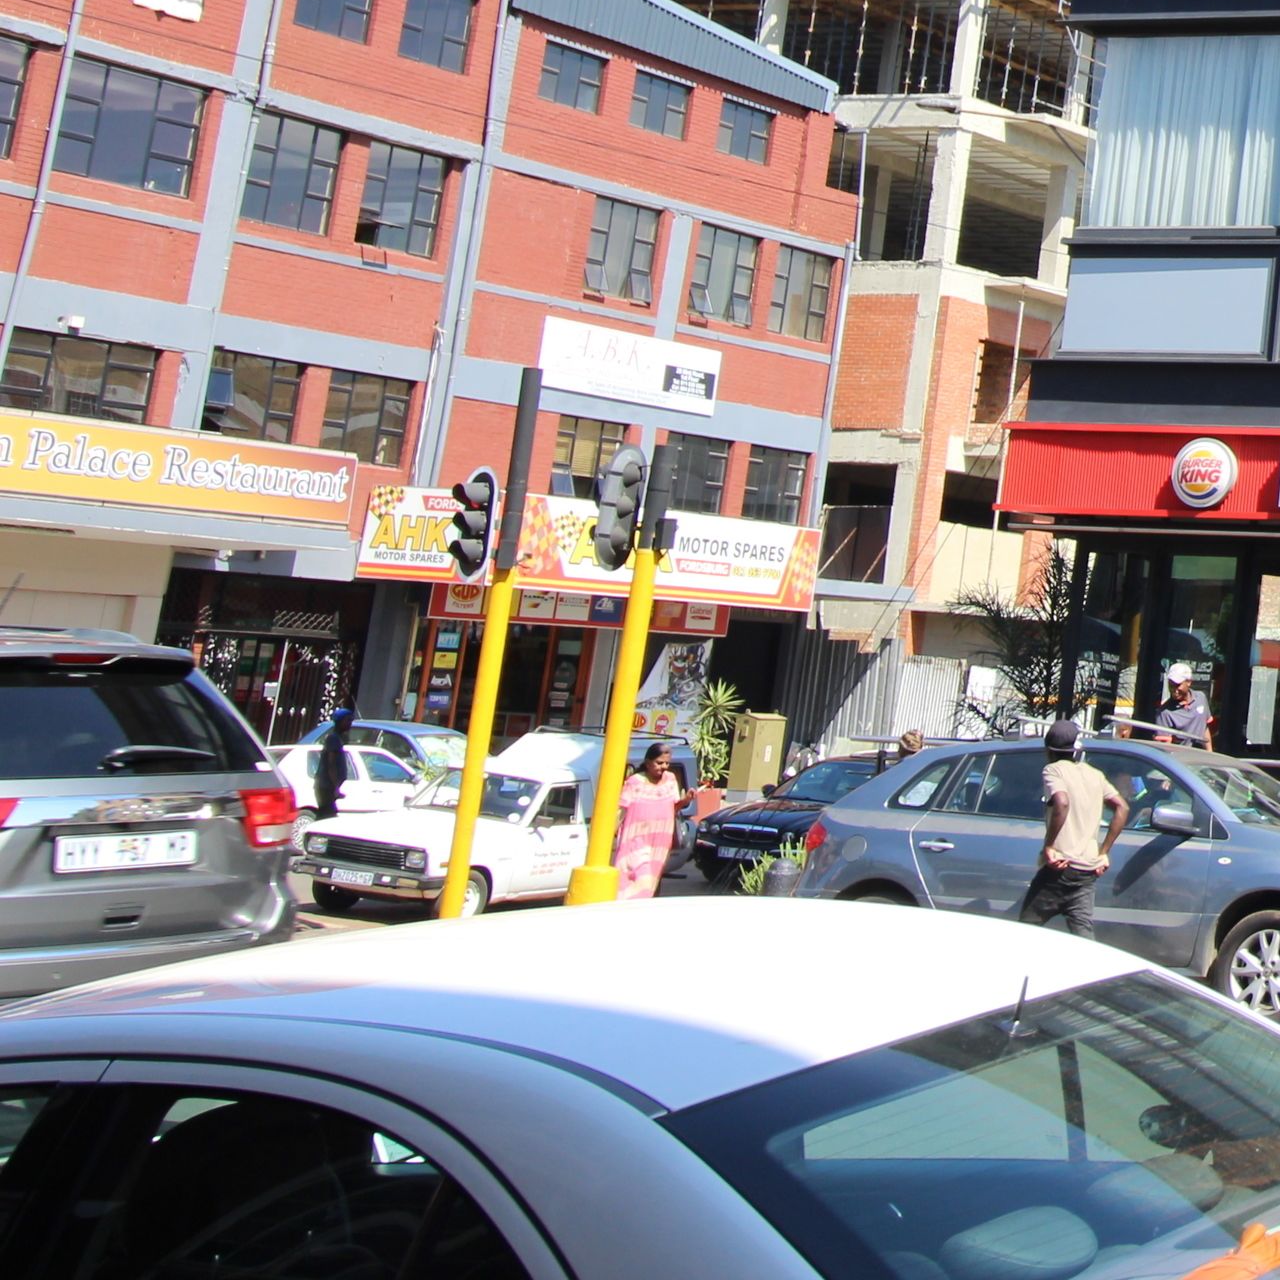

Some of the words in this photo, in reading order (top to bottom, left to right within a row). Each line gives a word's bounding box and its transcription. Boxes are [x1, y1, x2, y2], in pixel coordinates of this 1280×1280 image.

[24, 428, 152, 481] Palace
[162, 445, 350, 502] Restaurant
[1182, 457, 1223, 470] BURGER
[1179, 468, 1220, 485] KING
[370, 514, 453, 553] AHK
[374, 550, 406, 562] MOTOR
[409, 552, 445, 563] SPARES
[679, 536, 729, 557] MOTOR
[733, 541, 785, 563] SPARES
